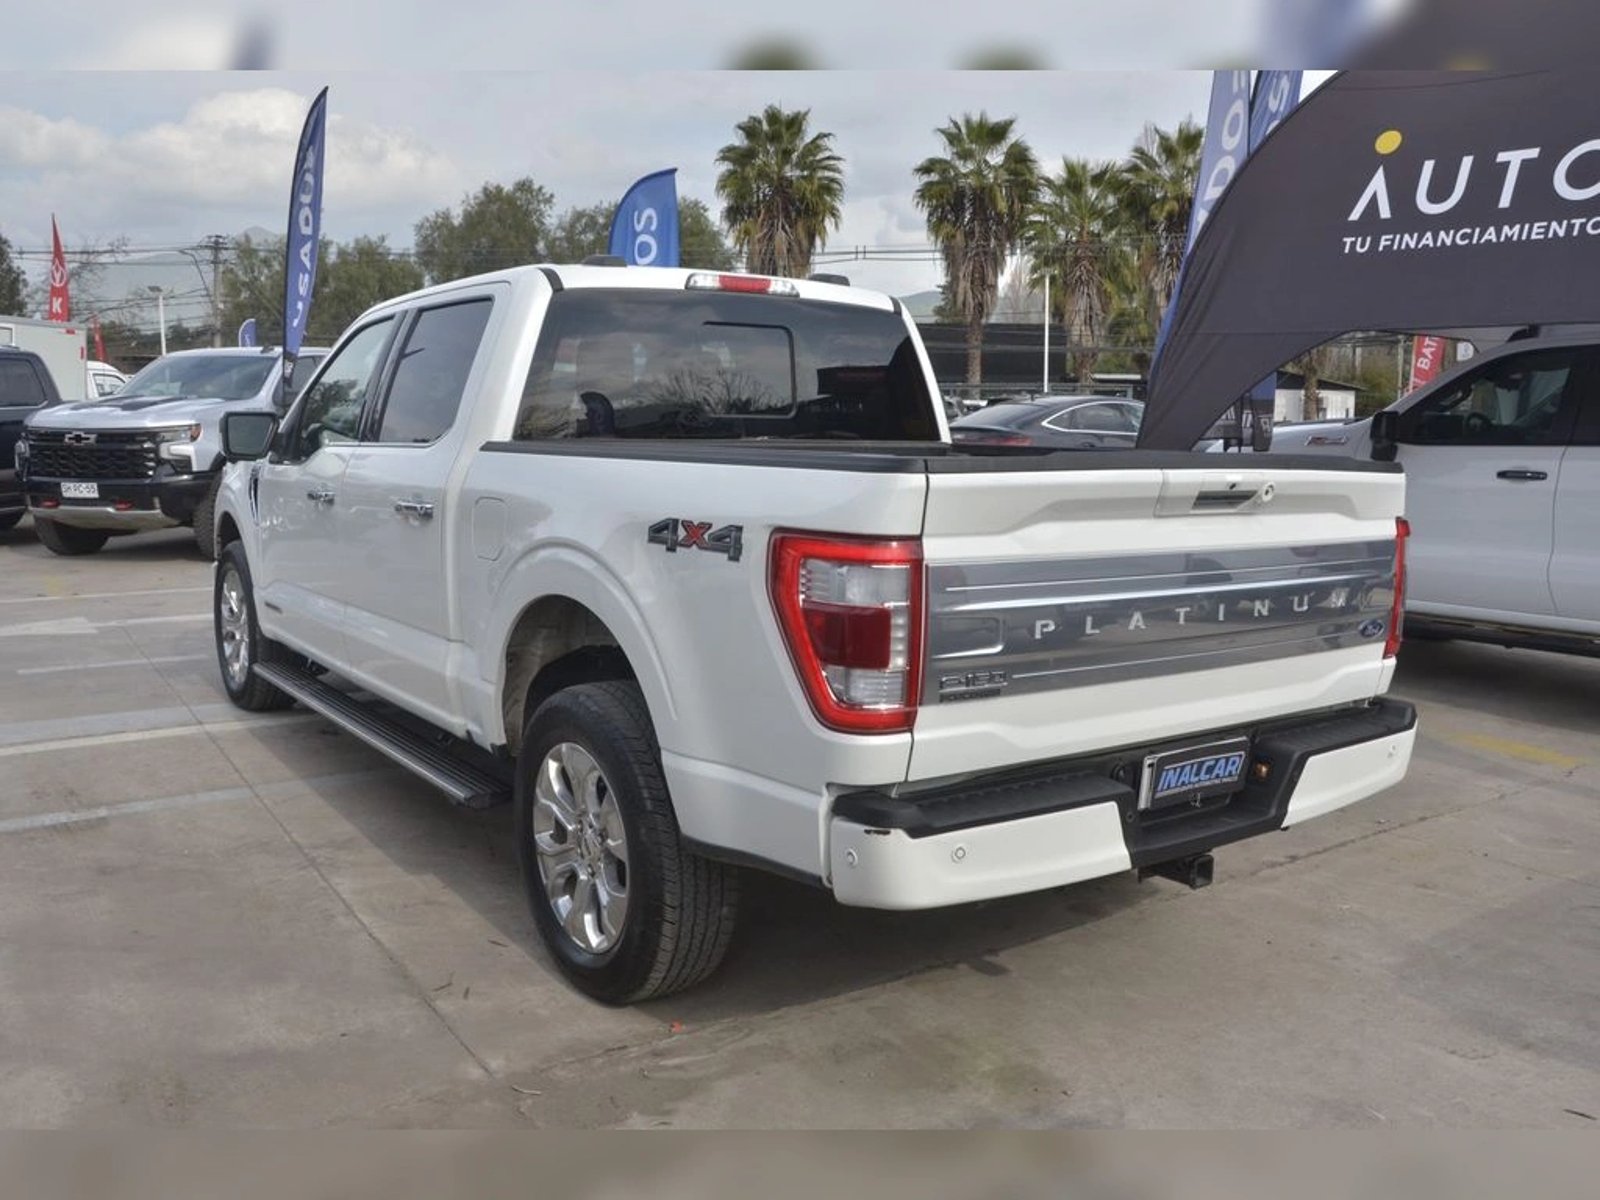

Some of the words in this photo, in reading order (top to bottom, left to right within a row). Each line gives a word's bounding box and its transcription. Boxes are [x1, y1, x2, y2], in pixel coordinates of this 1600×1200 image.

[1343, 237, 1371, 253] TU
[1034, 587, 1349, 639] PLATINUM
[1157, 756, 1241, 791] INALCAR
